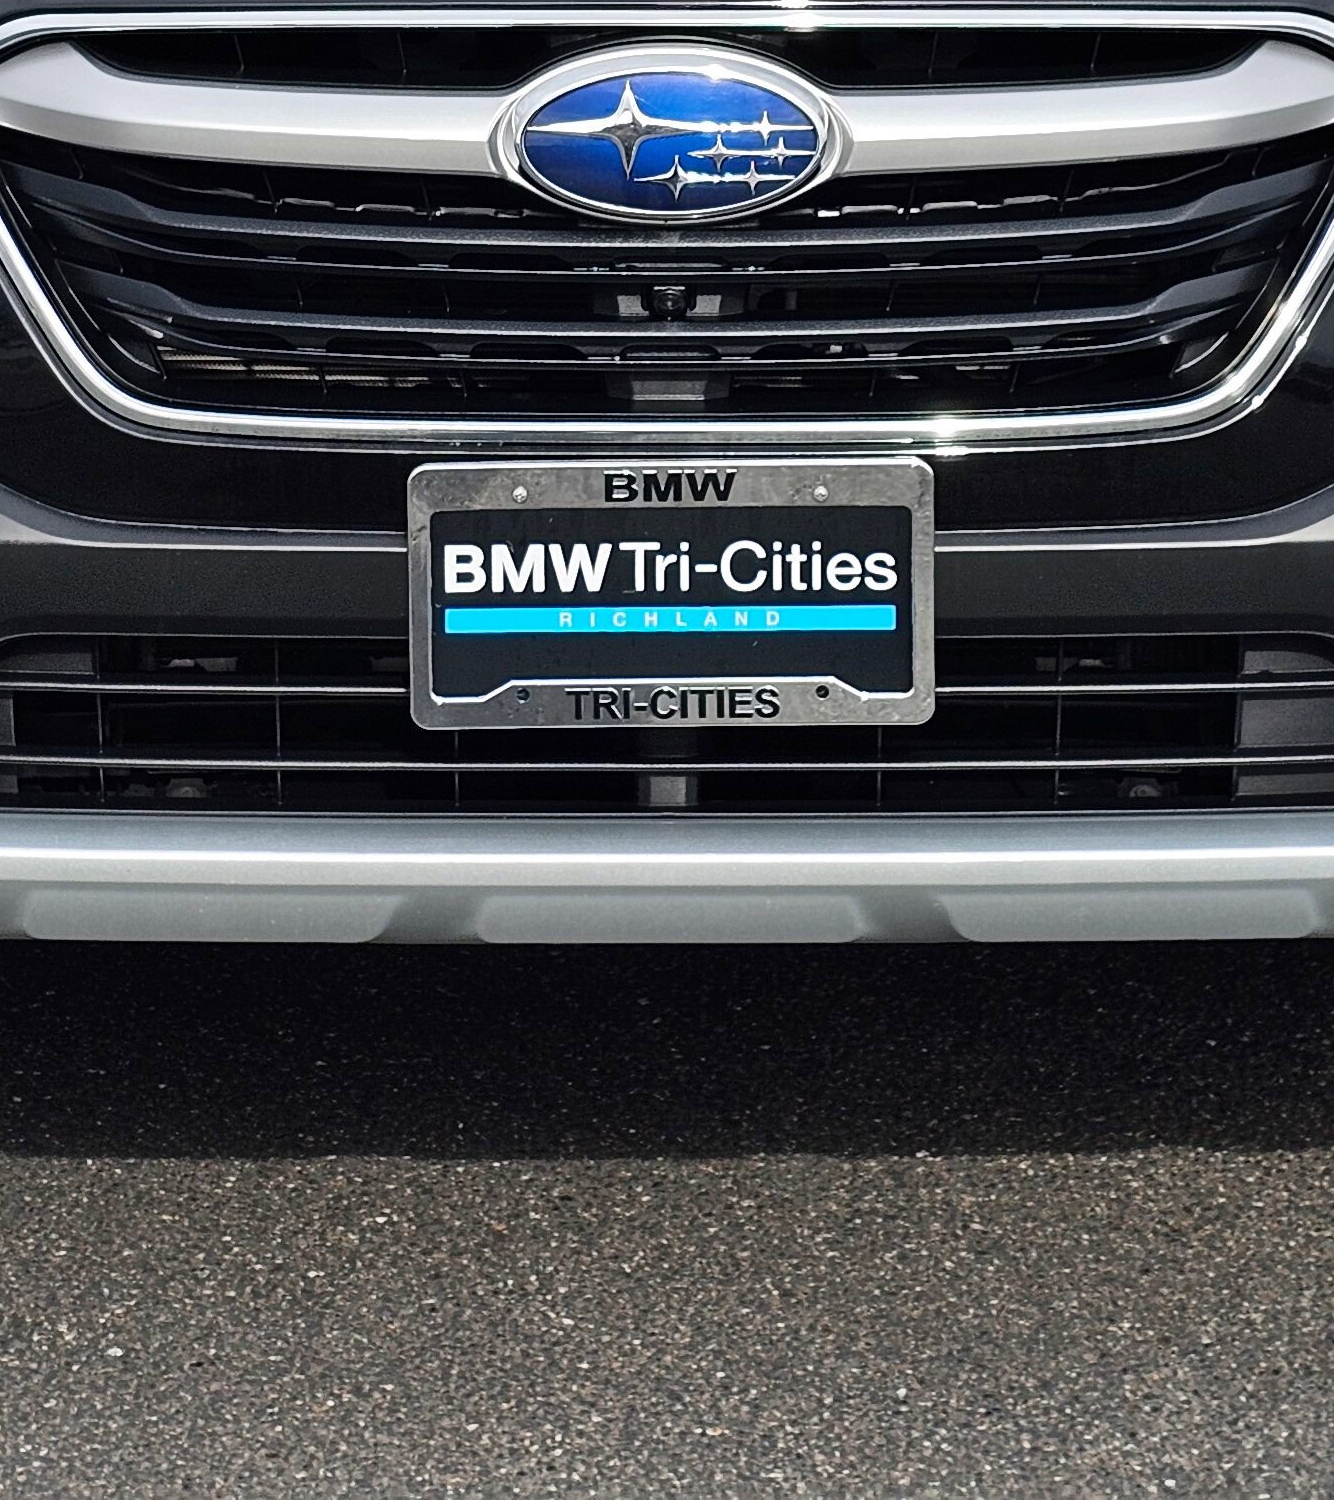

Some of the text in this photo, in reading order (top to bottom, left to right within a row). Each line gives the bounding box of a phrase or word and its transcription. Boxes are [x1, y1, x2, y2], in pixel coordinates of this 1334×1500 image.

[603, 469, 738, 503] BMW
[443, 539, 898, 594] BMW Tri-Cities
[558, 610, 781, 629] RICHLAND
[563, 684, 781, 720] TRI-CITIES
